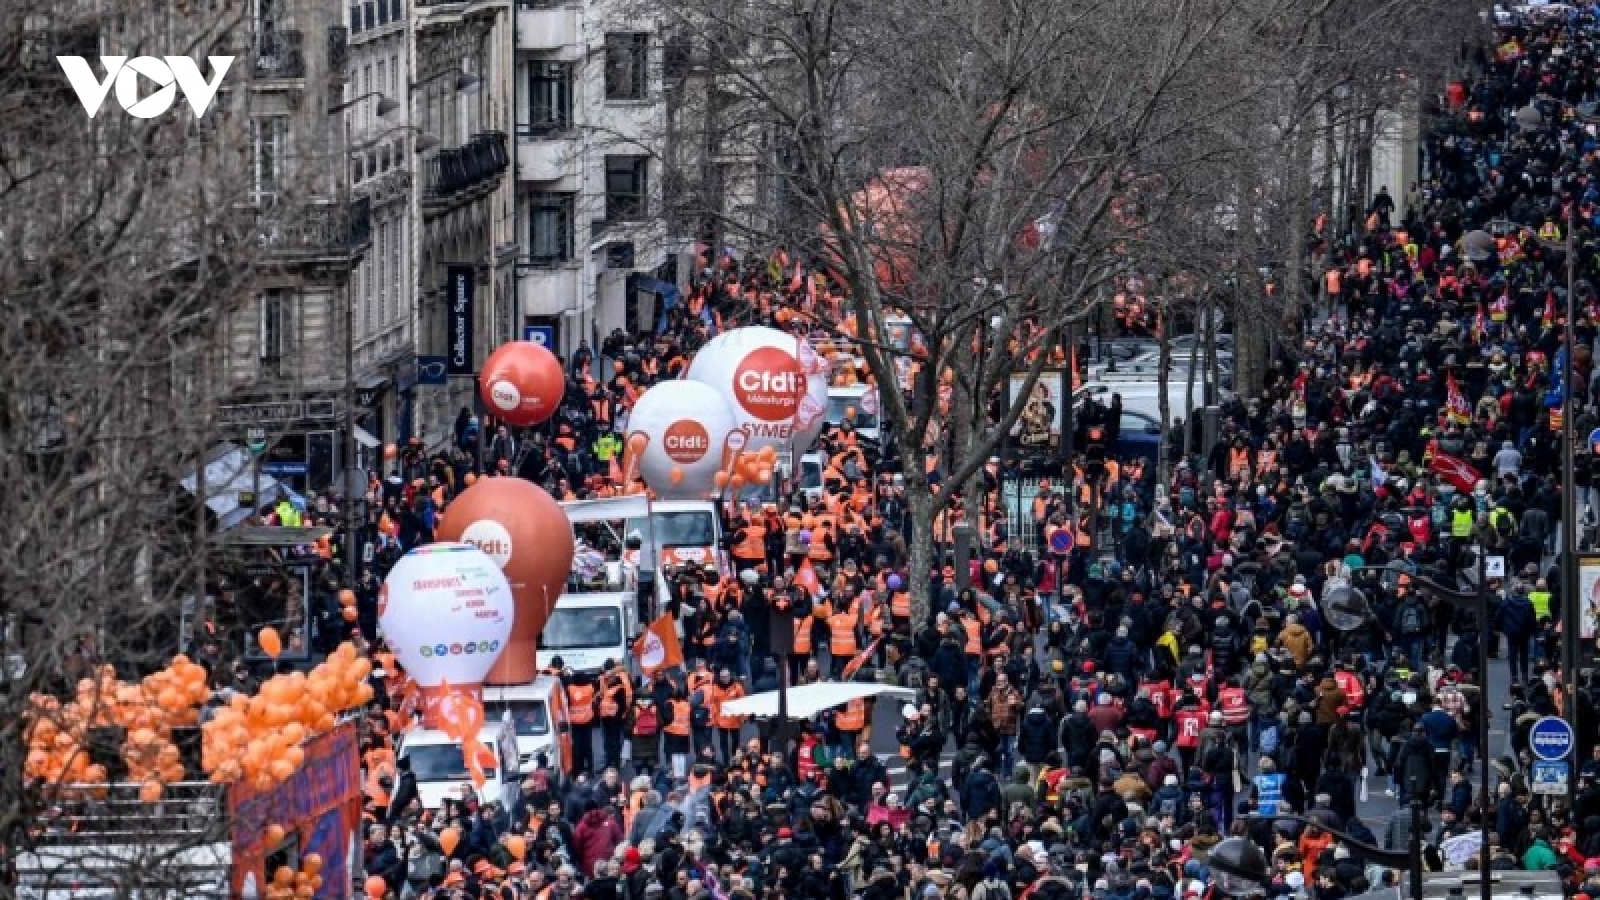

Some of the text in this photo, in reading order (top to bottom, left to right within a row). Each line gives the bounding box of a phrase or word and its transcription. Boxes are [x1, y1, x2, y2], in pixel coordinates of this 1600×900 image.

[453, 274, 468, 366] Collector Square
[740, 369, 804, 393] Cfdt:
[667, 435, 707, 449] Cfdt:
